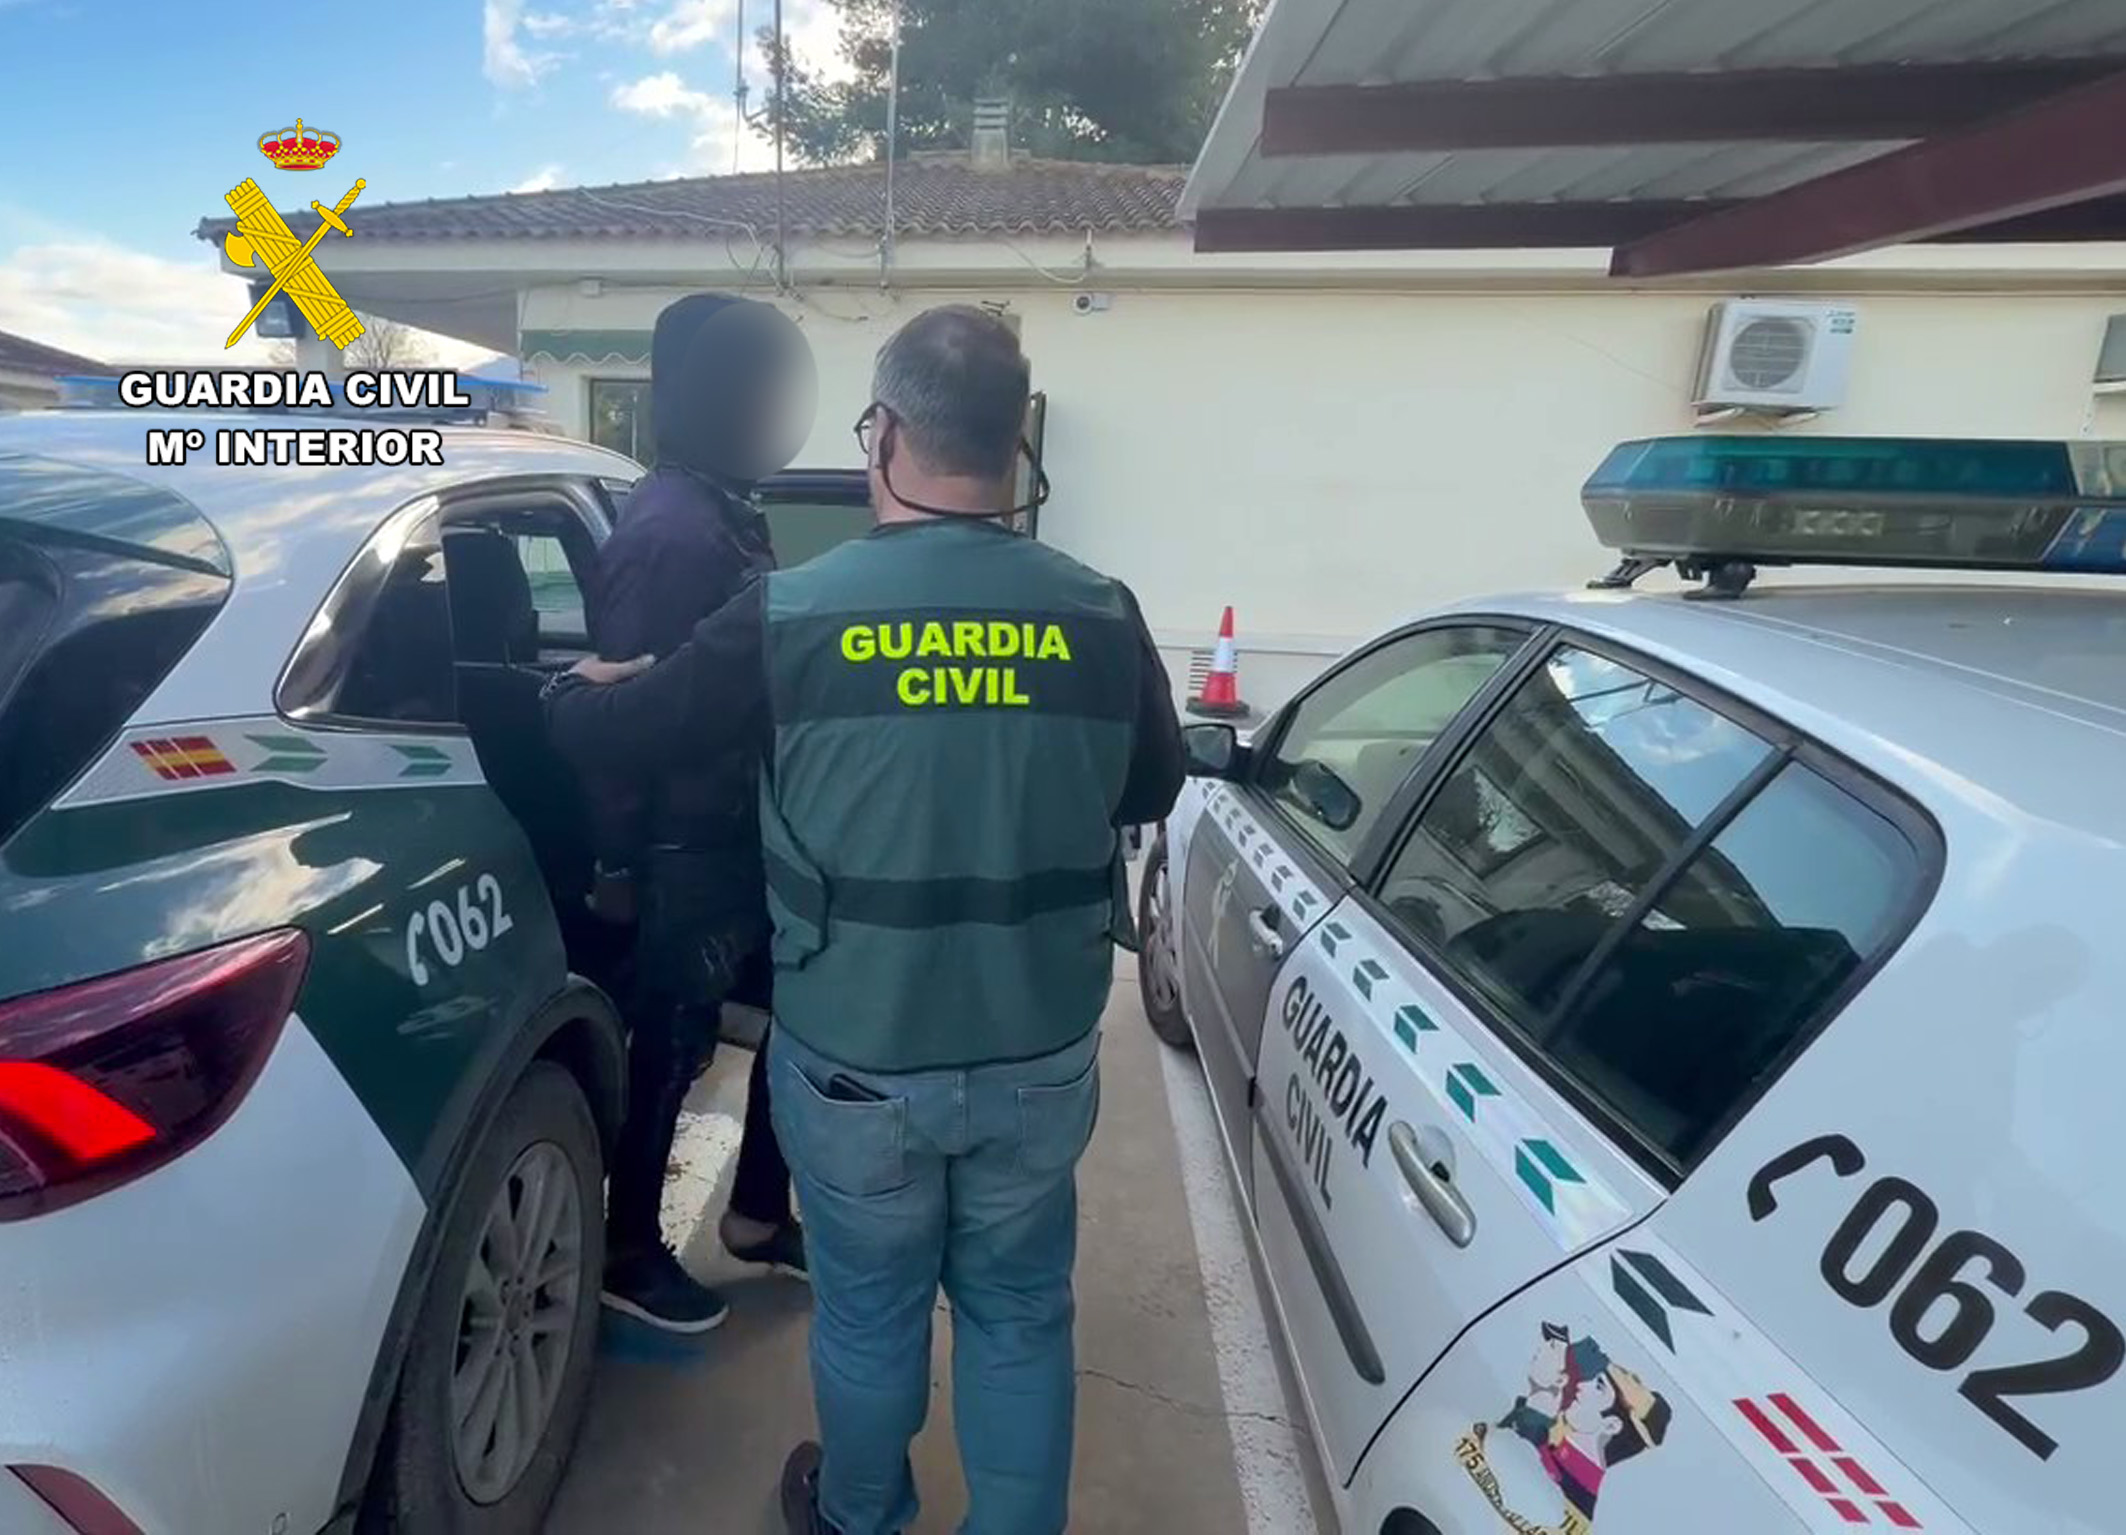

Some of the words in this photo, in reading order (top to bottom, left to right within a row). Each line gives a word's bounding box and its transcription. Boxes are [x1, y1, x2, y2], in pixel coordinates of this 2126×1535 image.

[841, 622, 1071, 661] GUARDIA
[897, 667, 1031, 705] CIVIL
[427, 873, 514, 967] 062
[1282, 976, 1388, 1169] GUARDIA
[1286, 1073, 1332, 1211] CIVIL
[1820, 1176, 2126, 1462] 062
[1455, 1438, 1485, 1470] 175
